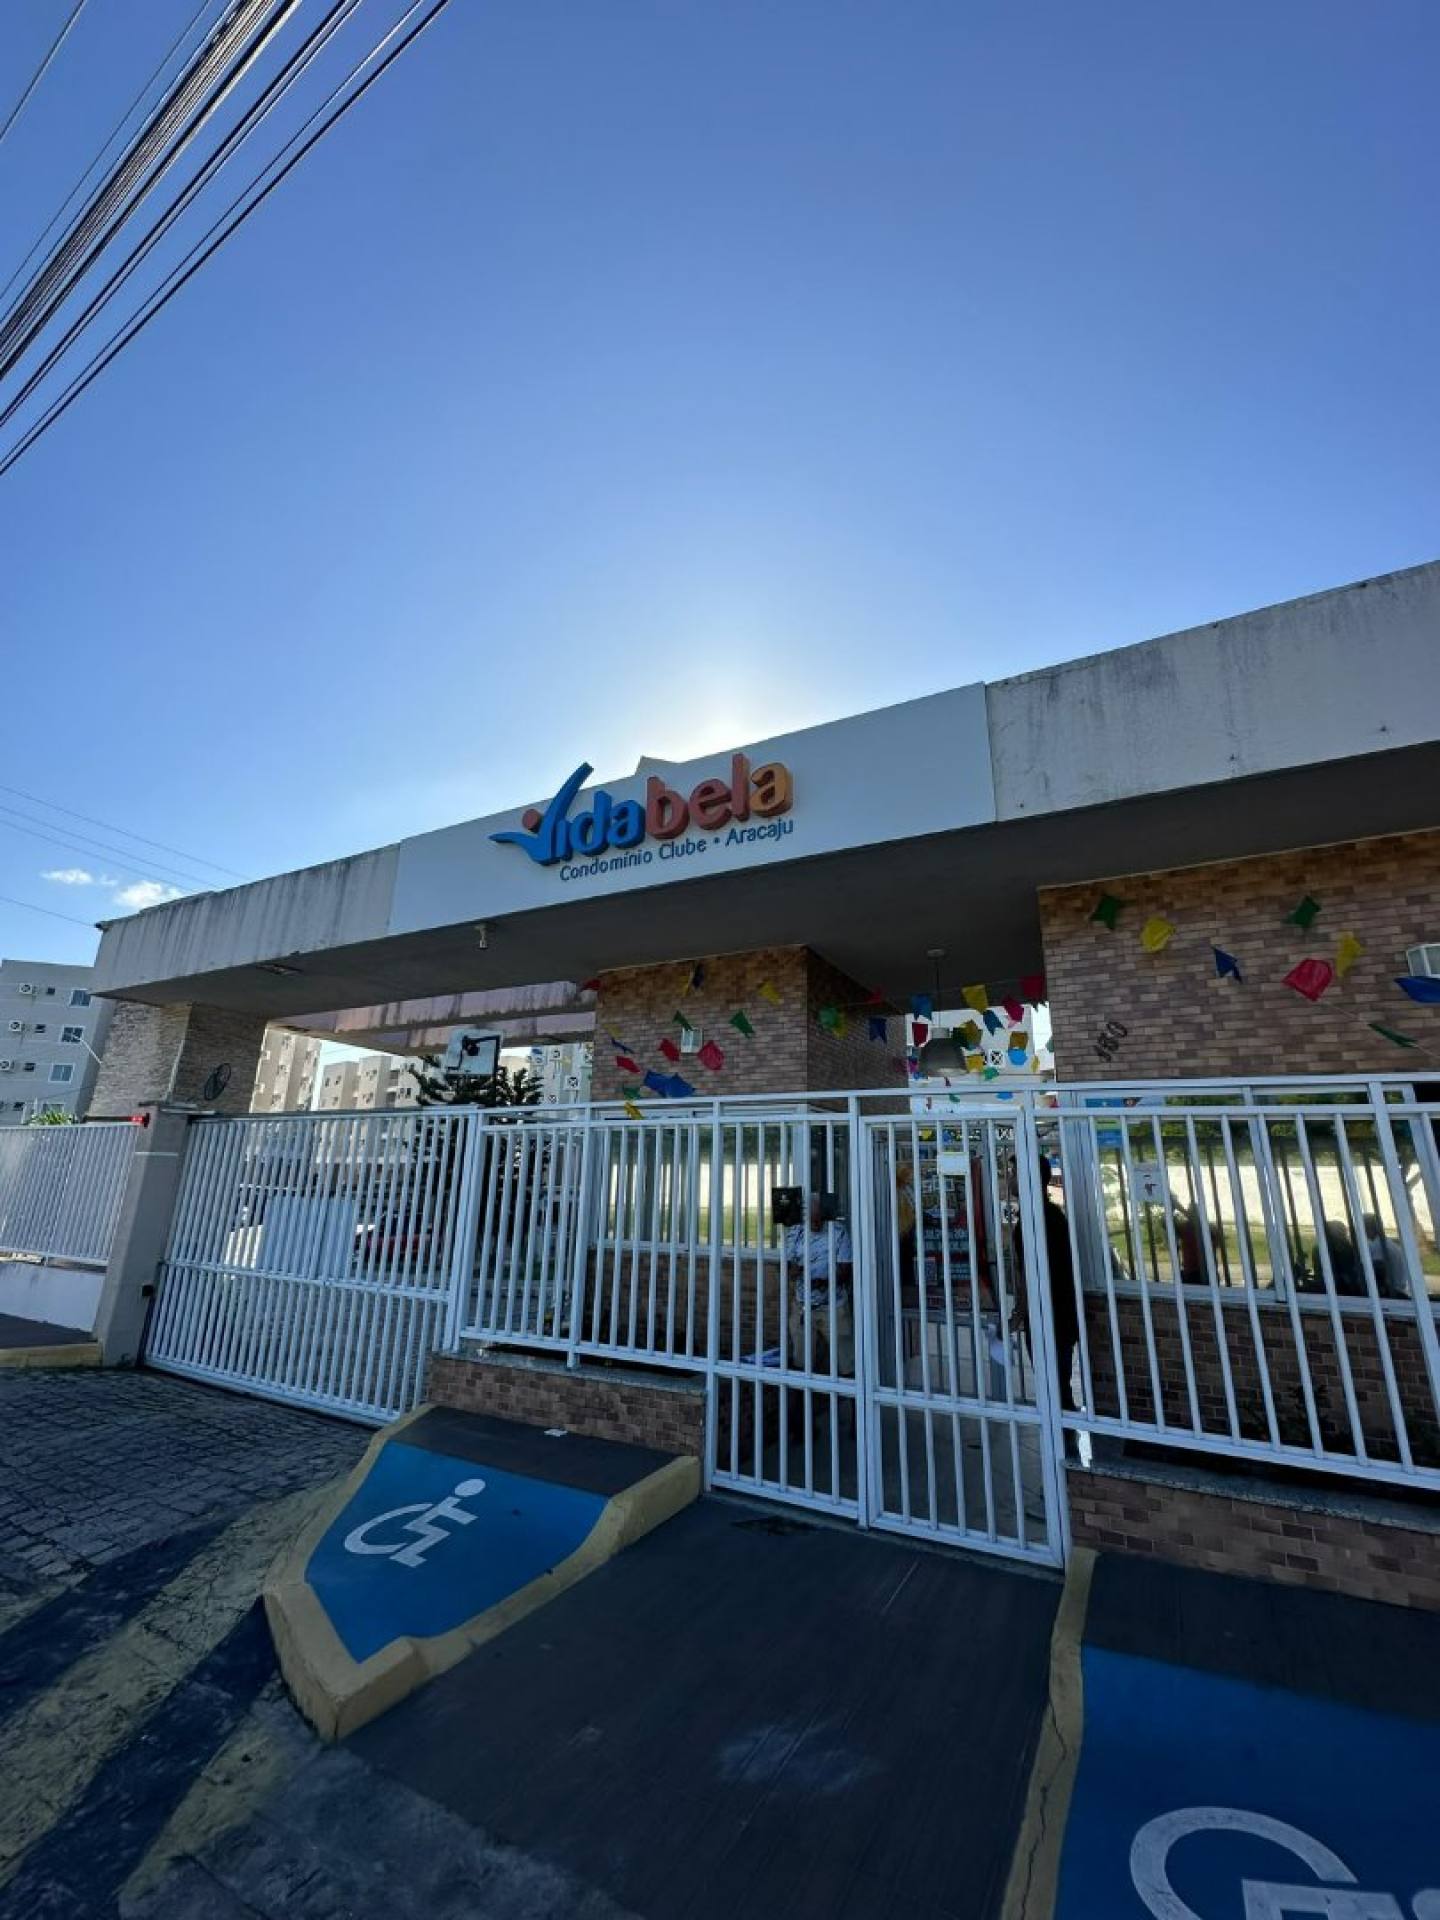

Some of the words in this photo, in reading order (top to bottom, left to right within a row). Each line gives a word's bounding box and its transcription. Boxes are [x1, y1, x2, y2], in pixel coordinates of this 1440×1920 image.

[559, 848, 653, 881] Condomínio
[659, 838, 707, 860] Clube
[725, 818, 794, 847] Aracaju
